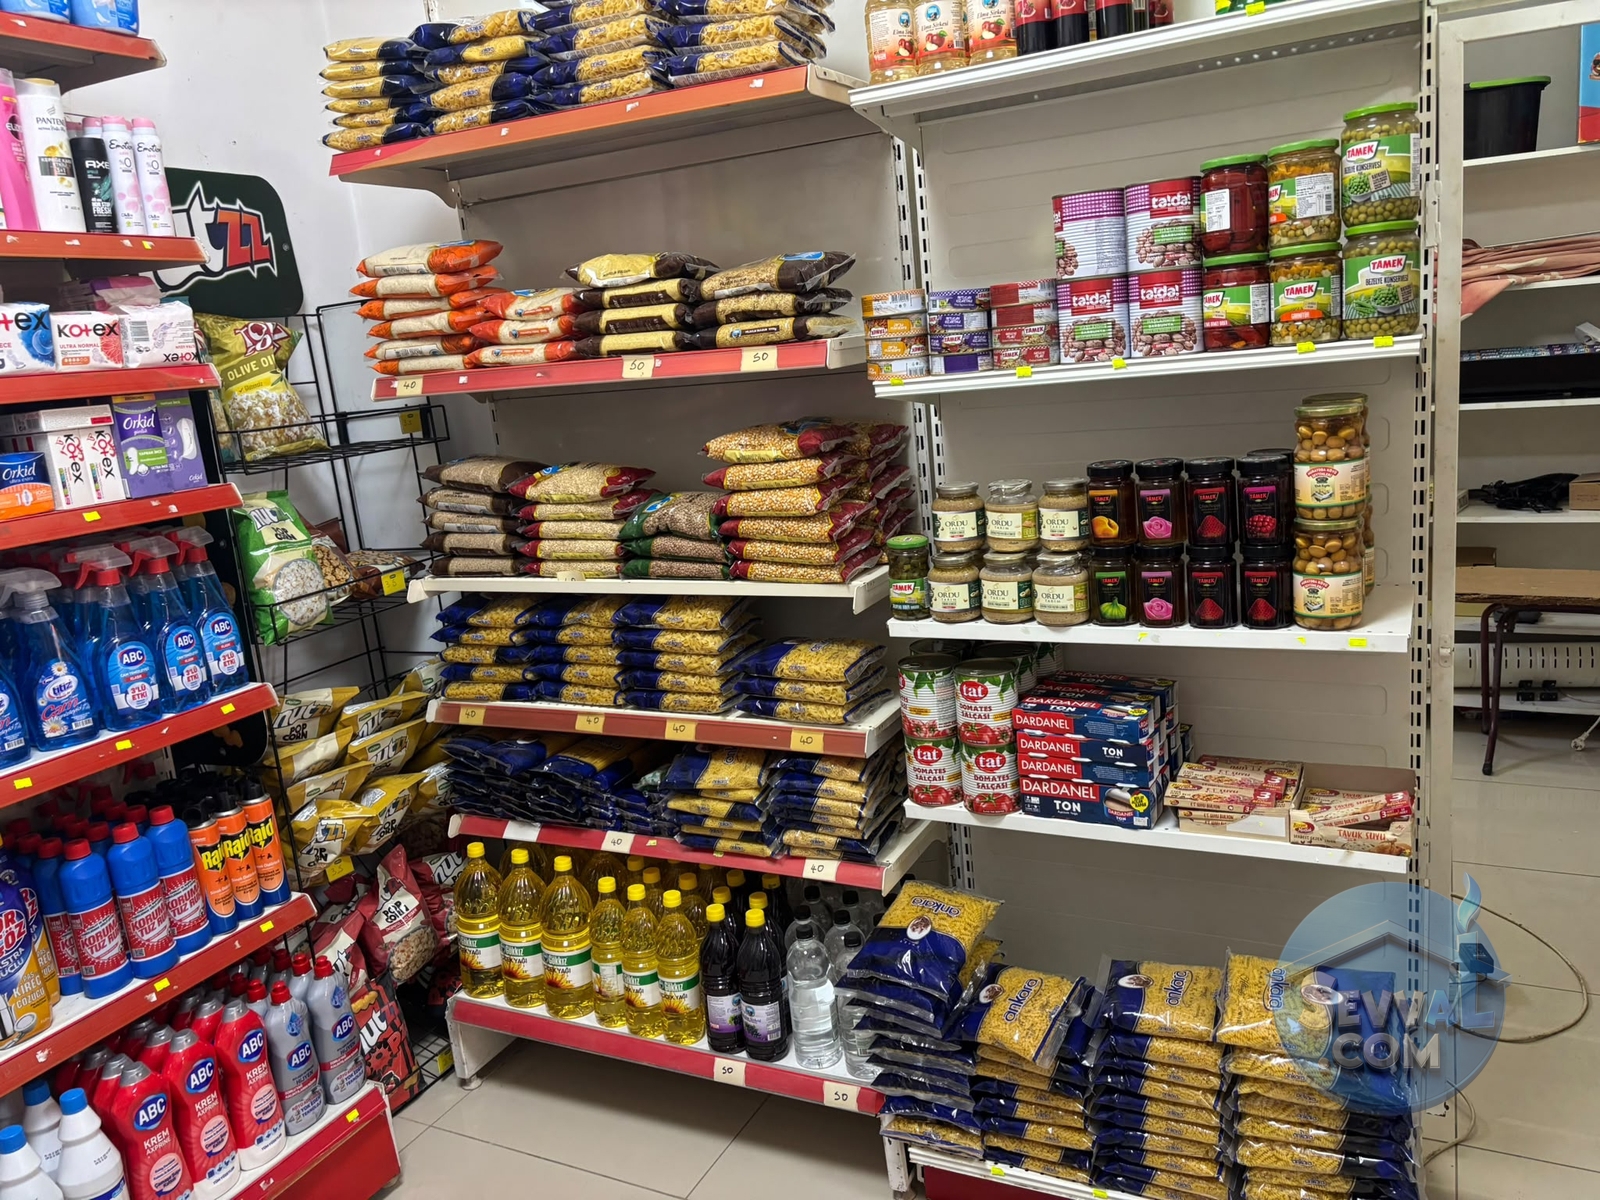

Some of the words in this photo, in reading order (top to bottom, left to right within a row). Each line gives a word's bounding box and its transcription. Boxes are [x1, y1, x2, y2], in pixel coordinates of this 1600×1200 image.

[932, 21, 949, 29] Sirkesi
[1347, 145, 1374, 159] TAMEK
[1371, 258, 1403, 270] TAMEK
[1366, 278, 1383, 286] BEZELYE
[1285, 285, 1315, 296] TAMEK
[1025, 326, 1045, 334] TAMEK
[752, 351, 769, 363] 50
[1002, 351, 1019, 359] TAMEK
[227, 361, 260, 381] OLIVE
[629, 360, 645, 371] 50
[403, 380, 417, 390] 40
[123, 413, 156, 430] Orkid
[2, 462, 36, 481] Orkid
[945, 519, 969, 527] ORDU
[991, 519, 1013, 527] ORDU
[1046, 518, 1069, 526] ORDU
[987, 589, 1009, 597] ORDU
[1041, 592, 1065, 600] ORDU
[214, 620, 231, 634] ABC
[177, 634, 194, 648] ABC
[122, 650, 144, 665] ABC
[1055, 670, 1130, 681] DARDANEL
[52, 679, 73, 696] titiz
[962, 686, 985, 698] tat
[1035, 684, 1111, 696] DARDANEL
[41, 697, 79, 721] Cam
[959, 703, 993, 712] DOMATES
[1024, 696, 1098, 709] DARDANEL
[464, 710, 476, 719] 40
[586, 716, 600, 725] 40
[961, 711, 990, 721] SALÇASI
[290, 723, 306, 734] POP
[672, 722, 686, 734] 40
[1015, 714, 1071, 730] DARDANEL
[282, 731, 308, 741] CORN
[799, 735, 814, 745] 40
[1020, 736, 1077, 754] DARDANEL
[916, 749, 940, 762] tat
[1102, 746, 1123, 758] TON
[979, 755, 1003, 768] tat
[1020, 758, 1078, 776] DARDANEL
[913, 766, 947, 775] DOMATES
[915, 773, 945, 783] SALÇASI
[973, 774, 1010, 782] DOMATES
[976, 781, 1008, 791] SALÇASI
[1022, 777, 1097, 799] DARDANEL
[1053, 799, 1082, 813] TON
[1107, 808, 1134, 817] DARDANEL
[610, 836, 623, 847] 40
[1337, 829, 1363, 840] TAVUK
[1365, 832, 1387, 842] SUYU
[201, 843, 226, 870] Rai
[810, 863, 826, 874] 40
[166, 884, 200, 911] KORUM
[171, 902, 188, 918] TUZ
[910, 895, 961, 918] ankara
[131, 902, 167, 931] KORUM
[80, 919, 120, 949] KORUM
[139, 920, 158, 938] TUZ
[87, 938, 108, 955] TUZ
[1164, 970, 1189, 1006] ankara
[1271, 967, 1285, 1011] ankara
[1002, 977, 1040, 1023] ankara
[336, 1016, 354, 1038] ABC
[241, 1032, 264, 1059] ABC
[291, 1045, 311, 1067] ABC
[190, 1062, 214, 1088] ABC
[246, 1062, 268, 1082] KREM
[722, 1066, 734, 1074] 50
[194, 1091, 218, 1112] KREM
[834, 1092, 849, 1102] 50
[139, 1098, 166, 1126] ABC
[143, 1128, 170, 1150] KREM
